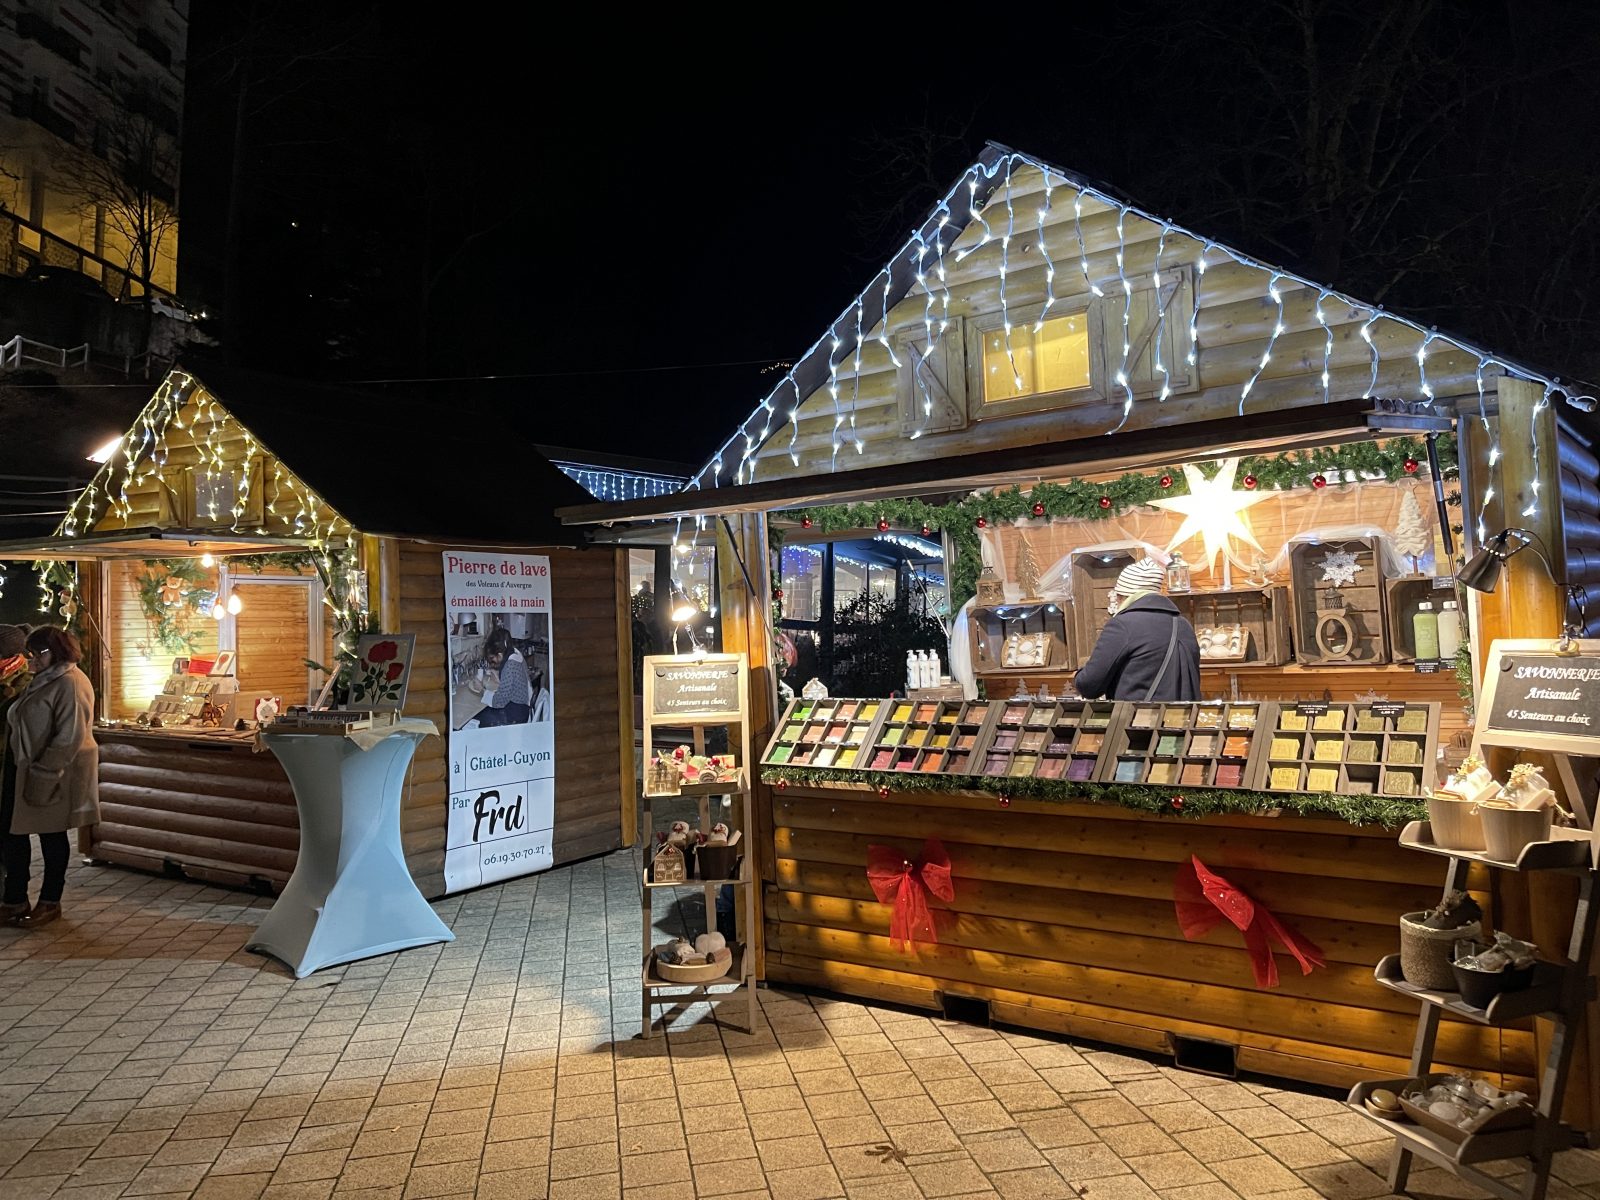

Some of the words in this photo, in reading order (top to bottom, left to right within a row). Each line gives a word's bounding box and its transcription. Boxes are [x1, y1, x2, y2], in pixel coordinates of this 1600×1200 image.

[448, 557, 496, 574] Pierre
[500, 560, 517, 576] de
[521, 561, 547, 577] lave
[477, 579, 499, 588] Volcans
[500, 580, 532, 590] d'Auvergne
[451, 595, 497, 608] émaillée
[500, 595, 506, 608] à
[509, 596, 518, 608] la
[520, 596, 545, 608] main
[666, 670, 729, 681] SAVONNERIE
[1514, 666, 1600, 681] SAVONNERIE
[677, 683, 717, 693] Artisanale
[1523, 687, 1582, 701] Artisanale
[1506, 709, 1519, 719] 45
[1518, 710, 1554, 722] Senteurs
[1566, 712, 1591, 726] choix
[454, 761, 460, 774] à
[470, 751, 551, 770] Châtel-Guyon
[452, 796, 471, 810] Par
[472, 789, 525, 843] Frd
[484, 846, 545, 865] 06.19.30.70.27
